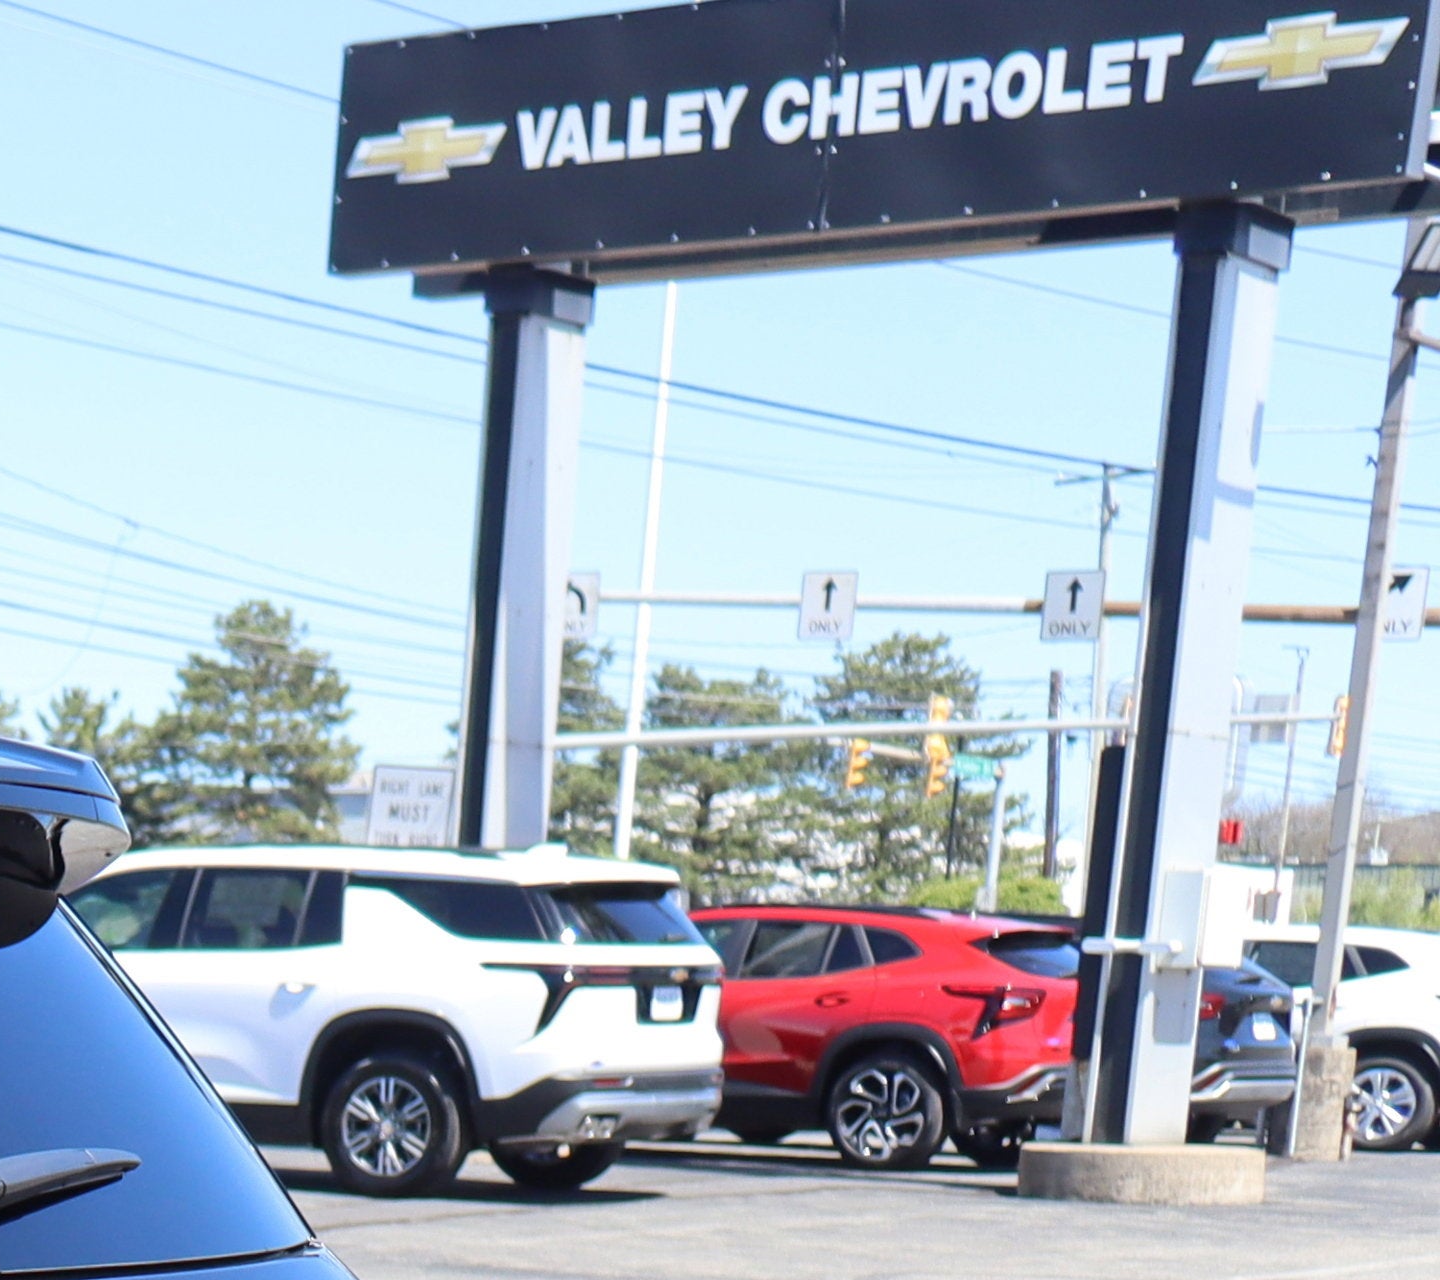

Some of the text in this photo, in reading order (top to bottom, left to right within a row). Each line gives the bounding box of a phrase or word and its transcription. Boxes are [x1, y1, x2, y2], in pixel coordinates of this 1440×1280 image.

[516, 34, 1184, 171] VALLEY CHEVROLET
[809, 619, 843, 634] ONLY
[1048, 620, 1091, 636] ONLY
[1383, 619, 1415, 633] NLY
[381, 779, 445, 798] RIGHT LANE
[388, 802, 430, 823] MUST
